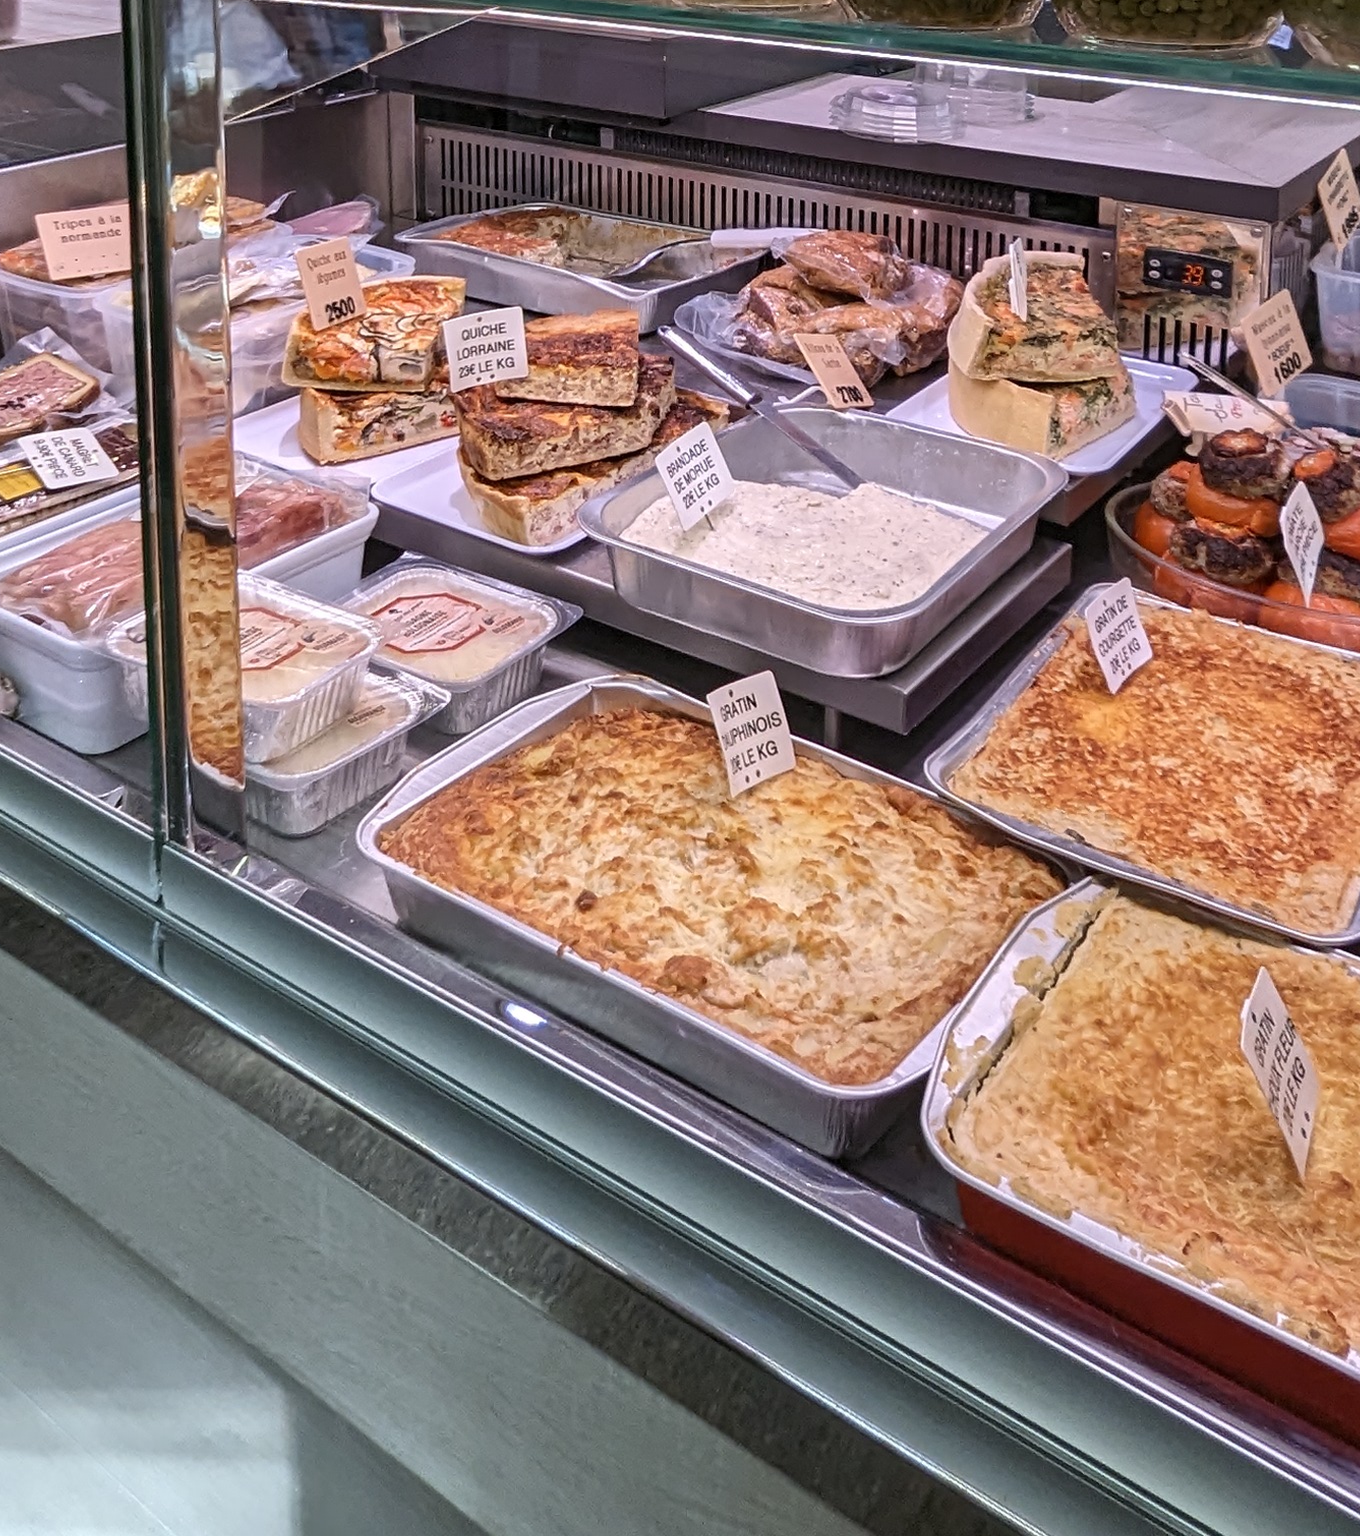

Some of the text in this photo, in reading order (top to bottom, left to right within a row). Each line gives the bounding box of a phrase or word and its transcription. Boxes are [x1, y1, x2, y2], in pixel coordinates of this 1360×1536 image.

[53, 219, 92, 231] Tripes
[61, 228, 122, 243] normande
[461, 322, 507, 341] QUICHE
[457, 339, 515, 361] LORRAINE
[458, 356, 515, 379] 23€ LE KG
[51, 436, 86, 477] DE CANARD
[666, 439, 709, 478] BRANDADE
[673, 455, 715, 495] DE MORUE
[694, 482, 707, 499] LE
[704, 473, 720, 491] KG
[1095, 595, 1128, 634] GRATIN DE
[1098, 615, 1137, 657] COURGETTE
[1129, 637, 1141, 655] KG
[720, 693, 757, 722] GRATIN
[742, 748, 756, 768] LE
[756, 740, 778, 761] KG
[1254, 1007, 1277, 1068] GRATIN
[1290, 1055, 1306, 1090] KG
